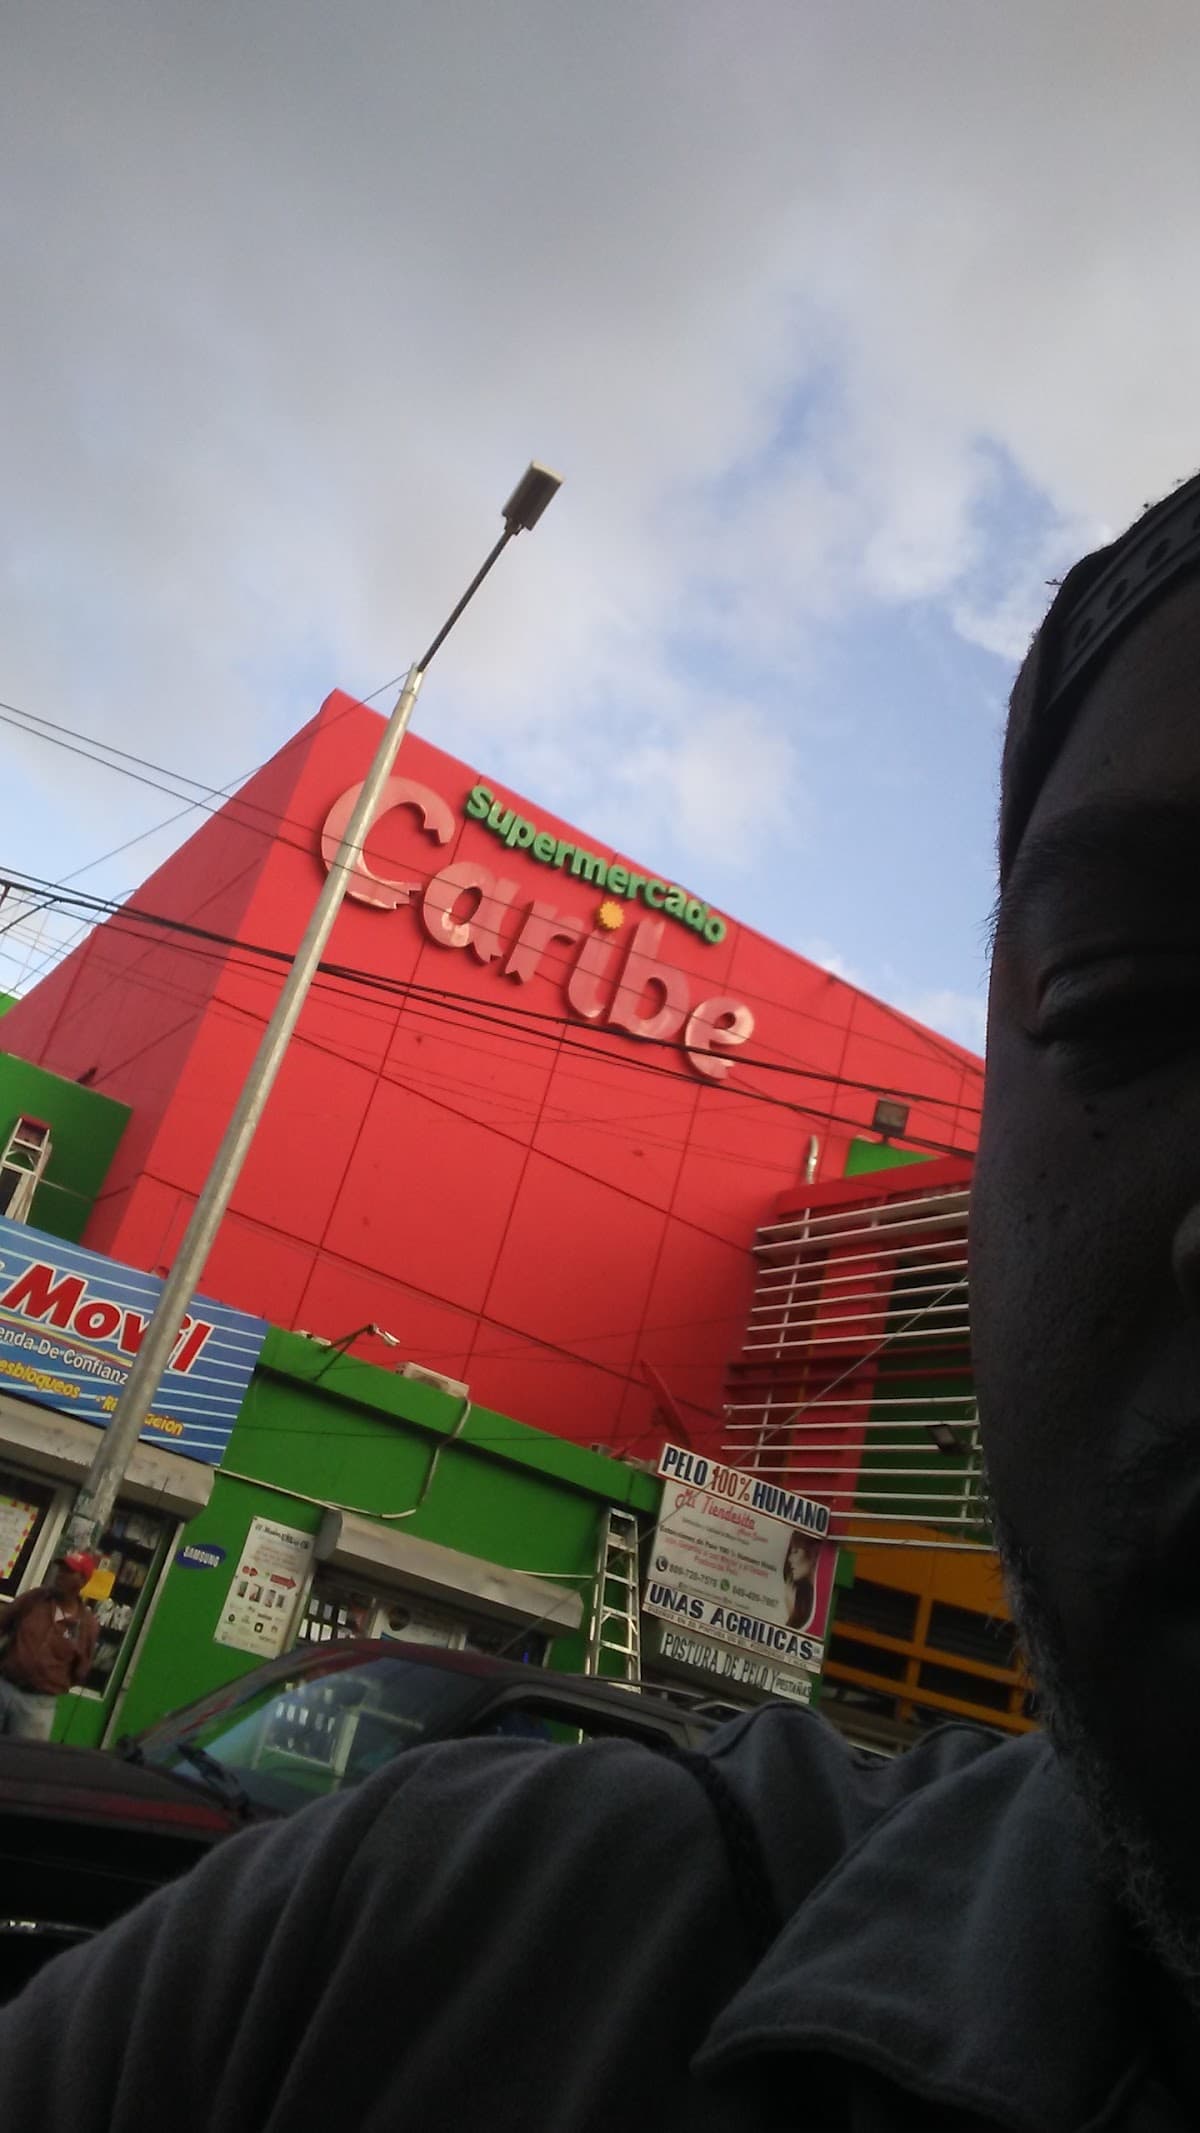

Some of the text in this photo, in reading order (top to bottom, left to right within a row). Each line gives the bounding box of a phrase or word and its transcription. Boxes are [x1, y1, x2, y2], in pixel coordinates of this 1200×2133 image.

[465, 785, 728, 944] Supermercado
[320, 775, 755, 1081] Caribe
[38, 1339, 60, 1359] De
[63, 1350, 129, 1385] Confianz
[661, 1445, 709, 1487] PELO
[711, 1464, 752, 1502] 100%
[752, 1482, 829, 1533] HUMANO
[649, 1583, 705, 1619] UNAS
[710, 1607, 814, 1660] ACRILICAS
[664, 1632, 718, 1672] POSTURA
[724, 1654, 740, 1679] DE
[742, 1659, 770, 1688] PELO
